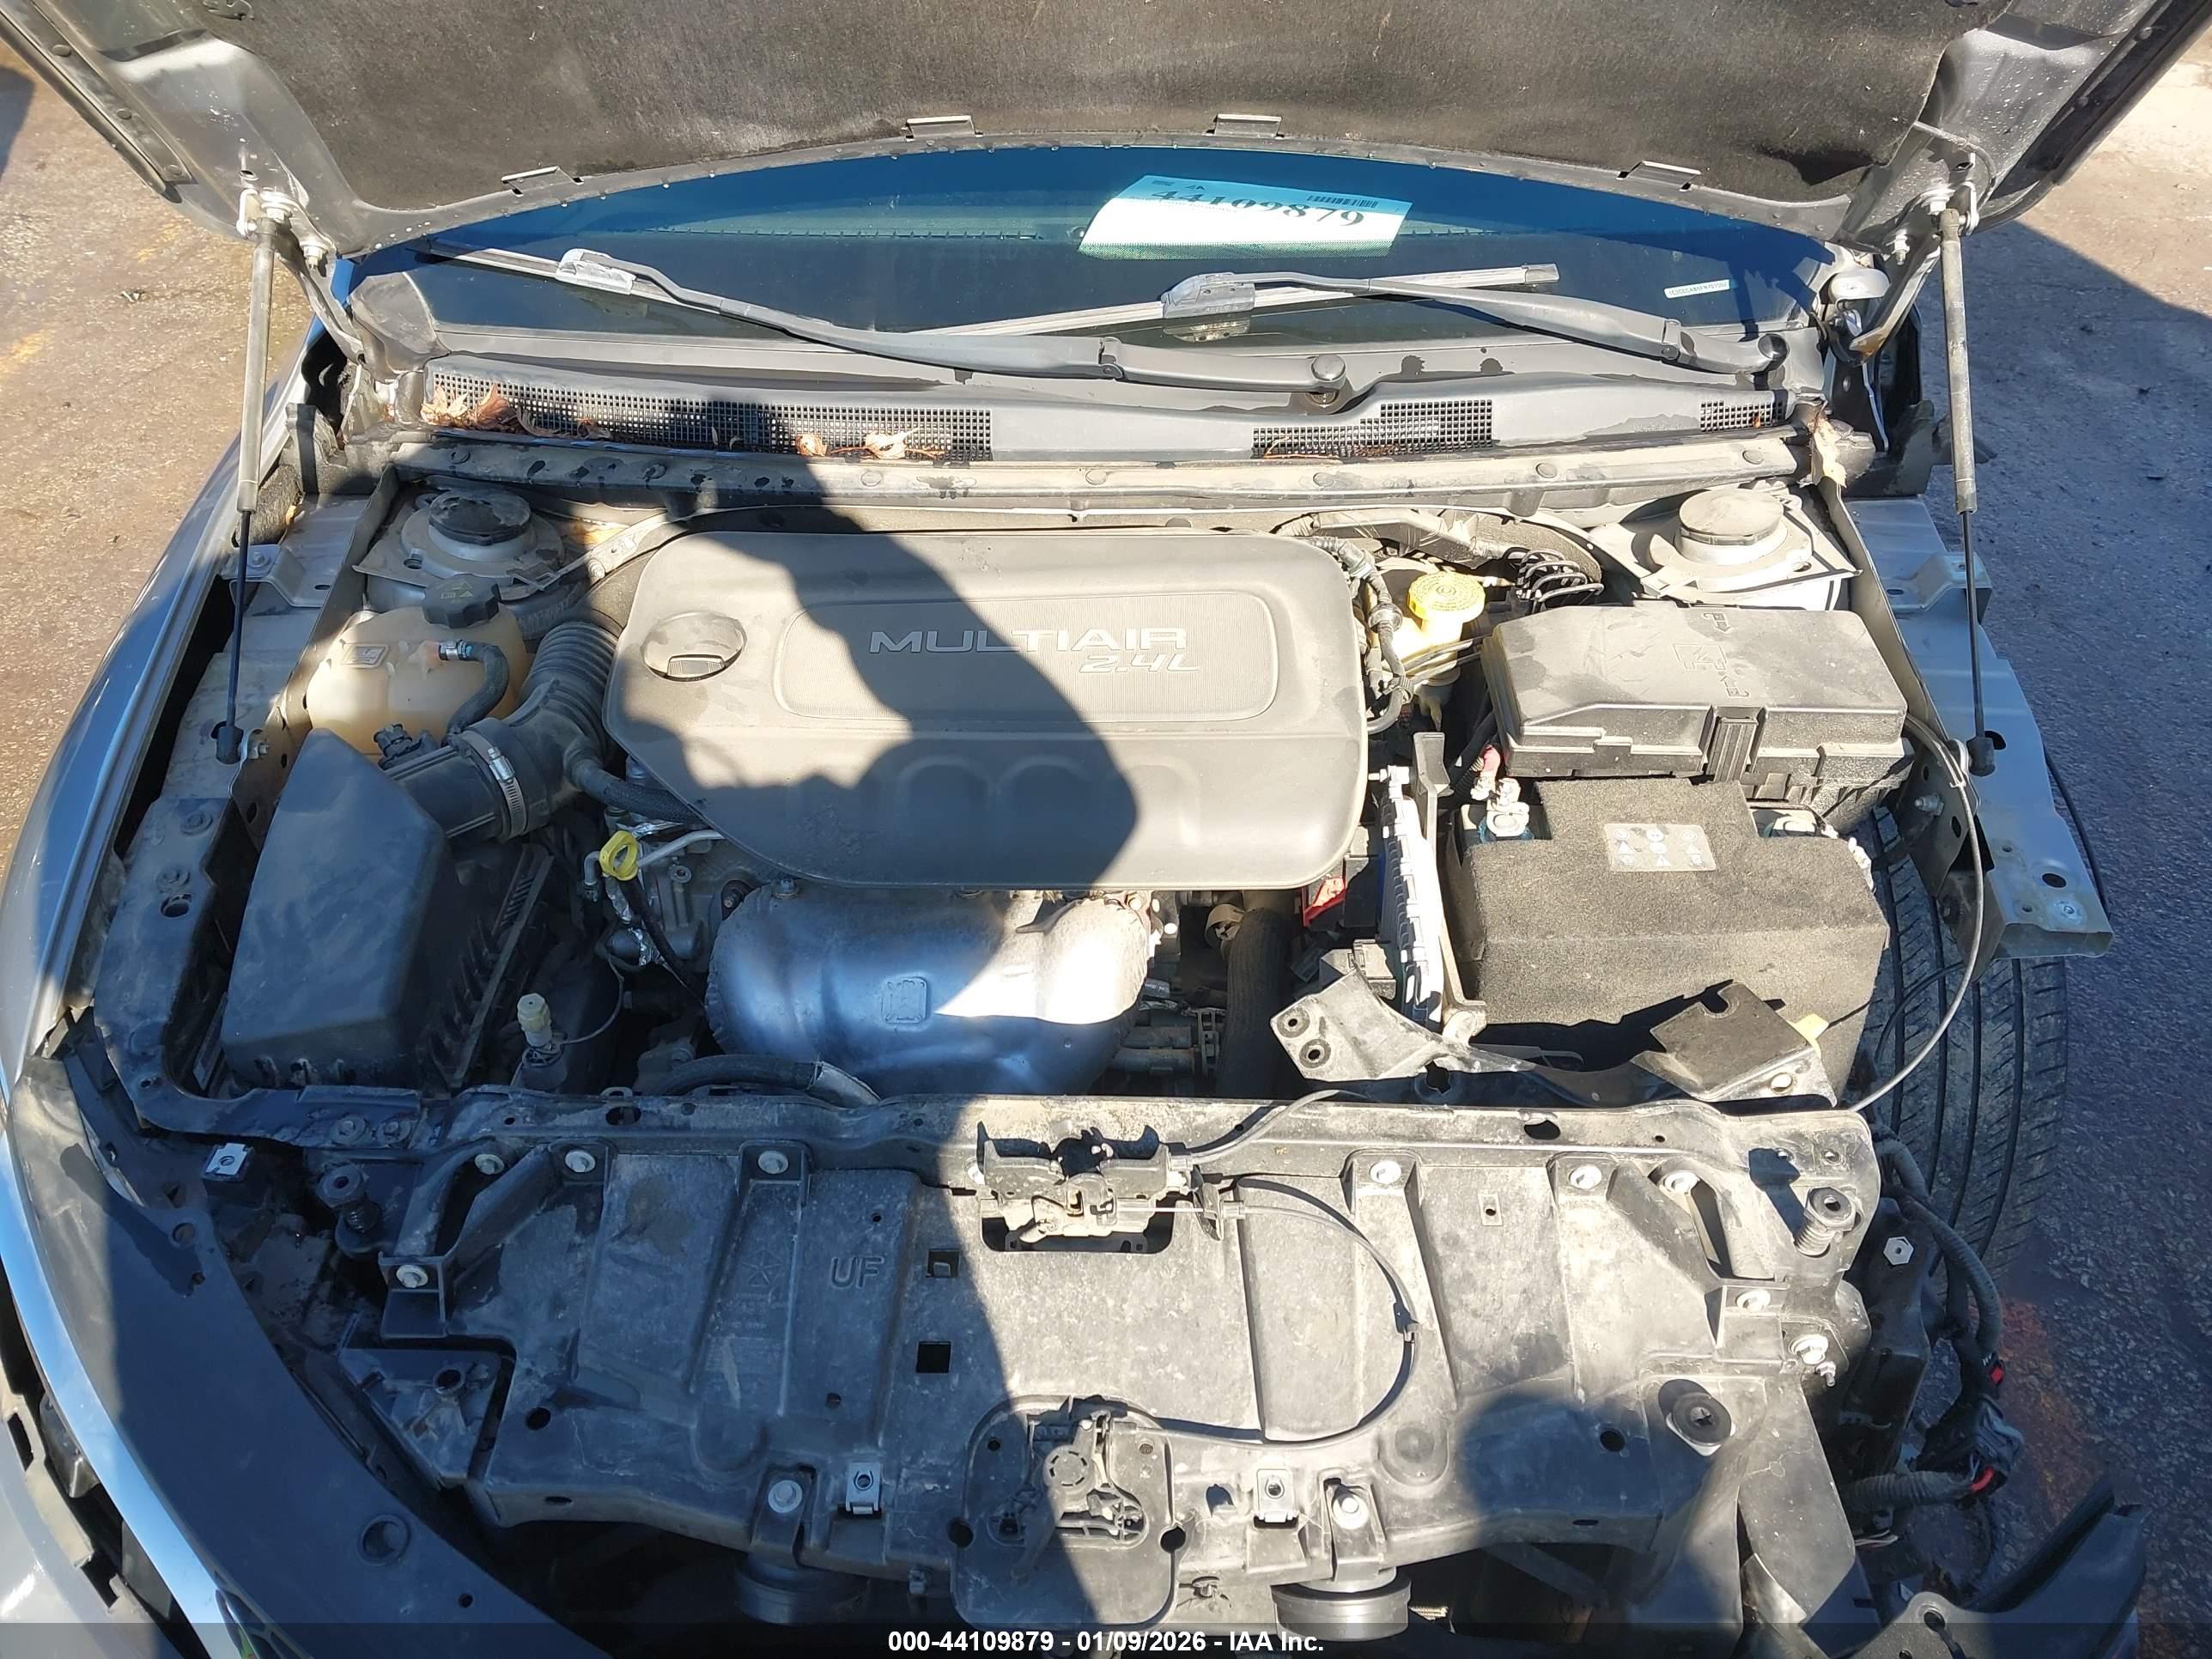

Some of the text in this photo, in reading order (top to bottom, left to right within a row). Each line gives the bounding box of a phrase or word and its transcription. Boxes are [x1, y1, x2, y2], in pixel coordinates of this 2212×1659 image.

[1151, 191, 1365, 228] 44109879
[869, 628, 1187, 653] MULTIAIR
[1079, 653, 1201, 674] 2.4L
[830, 1255, 885, 1289] UF
